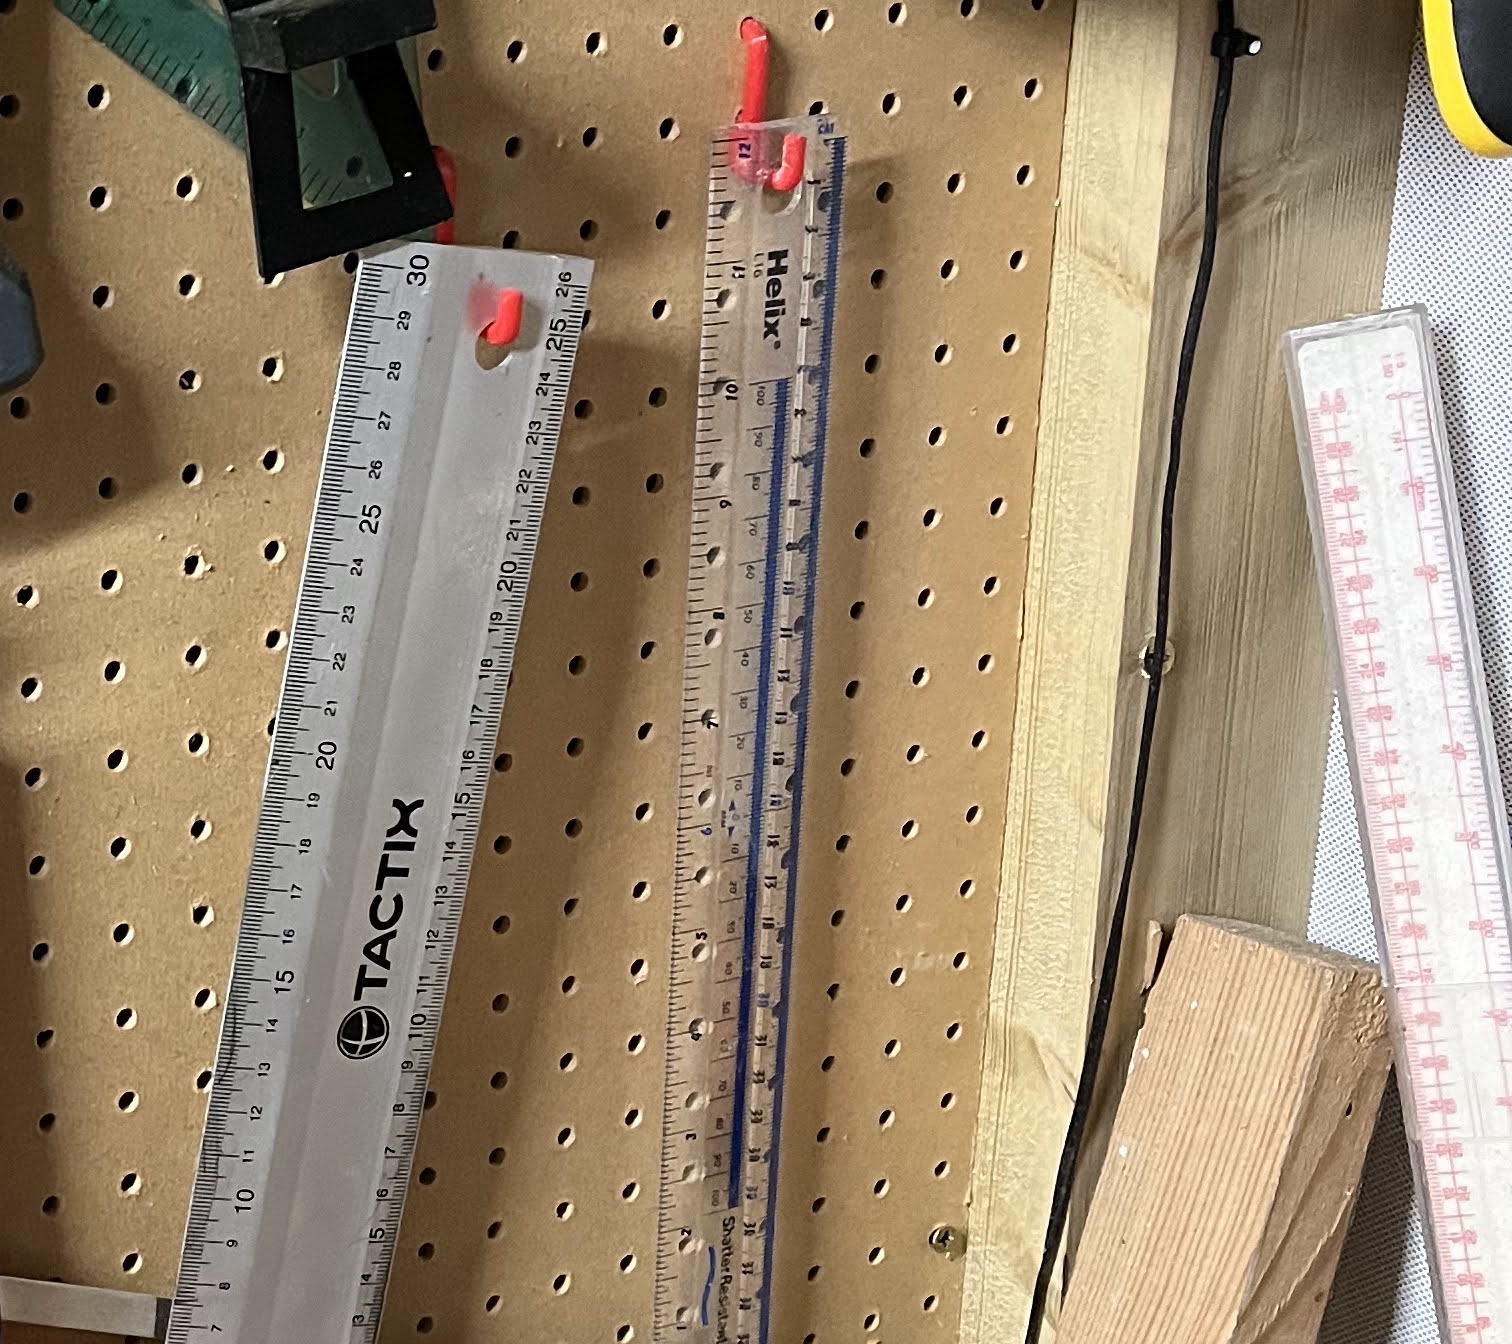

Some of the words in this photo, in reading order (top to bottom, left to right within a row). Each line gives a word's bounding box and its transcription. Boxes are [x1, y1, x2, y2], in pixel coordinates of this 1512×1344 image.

[406, 254, 430, 287] 30
[555, 271, 572, 298] 26
[396, 310, 412, 331] 29
[546, 318, 567, 351] 25
[387, 361, 402, 381] 28
[536, 372, 551, 396] 24
[725, 384, 739, 401] 10
[756, 385, 766, 406] 100
[378, 411, 392, 431] 27
[526, 420, 542, 446] 23
[754, 431, 763, 447] 90
[368, 459, 383, 480] 26
[516, 468, 532, 494] 22
[359, 504, 382, 535] 25
[506, 519, 521, 541] 21
[748, 522, 758, 537] 70
[350, 558, 364, 577] 24
[496, 560, 518, 592] 20
[745, 564, 756, 580] 60
[341, 605, 355, 624] 23
[488, 611, 503, 633] 19
[743, 609, 753, 623] 50
[332, 652, 347, 671] 22
[740, 652, 750, 667] 40
[478, 658, 494, 680] 18
[324, 700, 338, 717] 21
[469, 704, 485, 726] 17
[736, 736, 746, 750] 20
[315, 741, 338, 771] 20
[460, 749, 475, 771] 16
[734, 779, 743, 791] 10
[307, 792, 321, 809] 19
[451, 791, 472, 820] 15
[298, 838, 312, 856] 18
[442, 841, 457, 862] 14
[731, 843, 739, 854] 10
[290, 883, 303, 899] 17
[433, 885, 448, 906] 13
[729, 880, 737, 894] 20
[353, 798, 425, 1002] TACTIX
[282, 928, 295, 945] 16
[424, 929, 440, 950] 12
[273, 969, 295, 994] 15
[416, 975, 430, 994] 11
[722, 1000, 731, 1014] 50
[265, 1018, 279, 1033] 14
[408, 1012, 428, 1040] 10
[257, 1061, 271, 1078] 13
[401, 1060, 414, 1070] 9
[718, 1079, 727, 1092] 70
[250, 1105, 263, 1121] 12
[393, 1103, 405, 1113] 8
[242, 1149, 255, 1163] 11
[385, 1146, 397, 1156] 7
[713, 1153, 722, 1168] 90
[234, 1188, 255, 1214] 10
[376, 1188, 389, 1198] 6
[711, 1189, 720, 1207] 100
[369, 1227, 385, 1239] 5
[226, 1239, 238, 1248] 9
[218, 1282, 231, 1291] 8
[360, 1273, 372, 1282] 4
[352, 1314, 365, 1324] 3
[210, 1324, 223, 1333] 7
